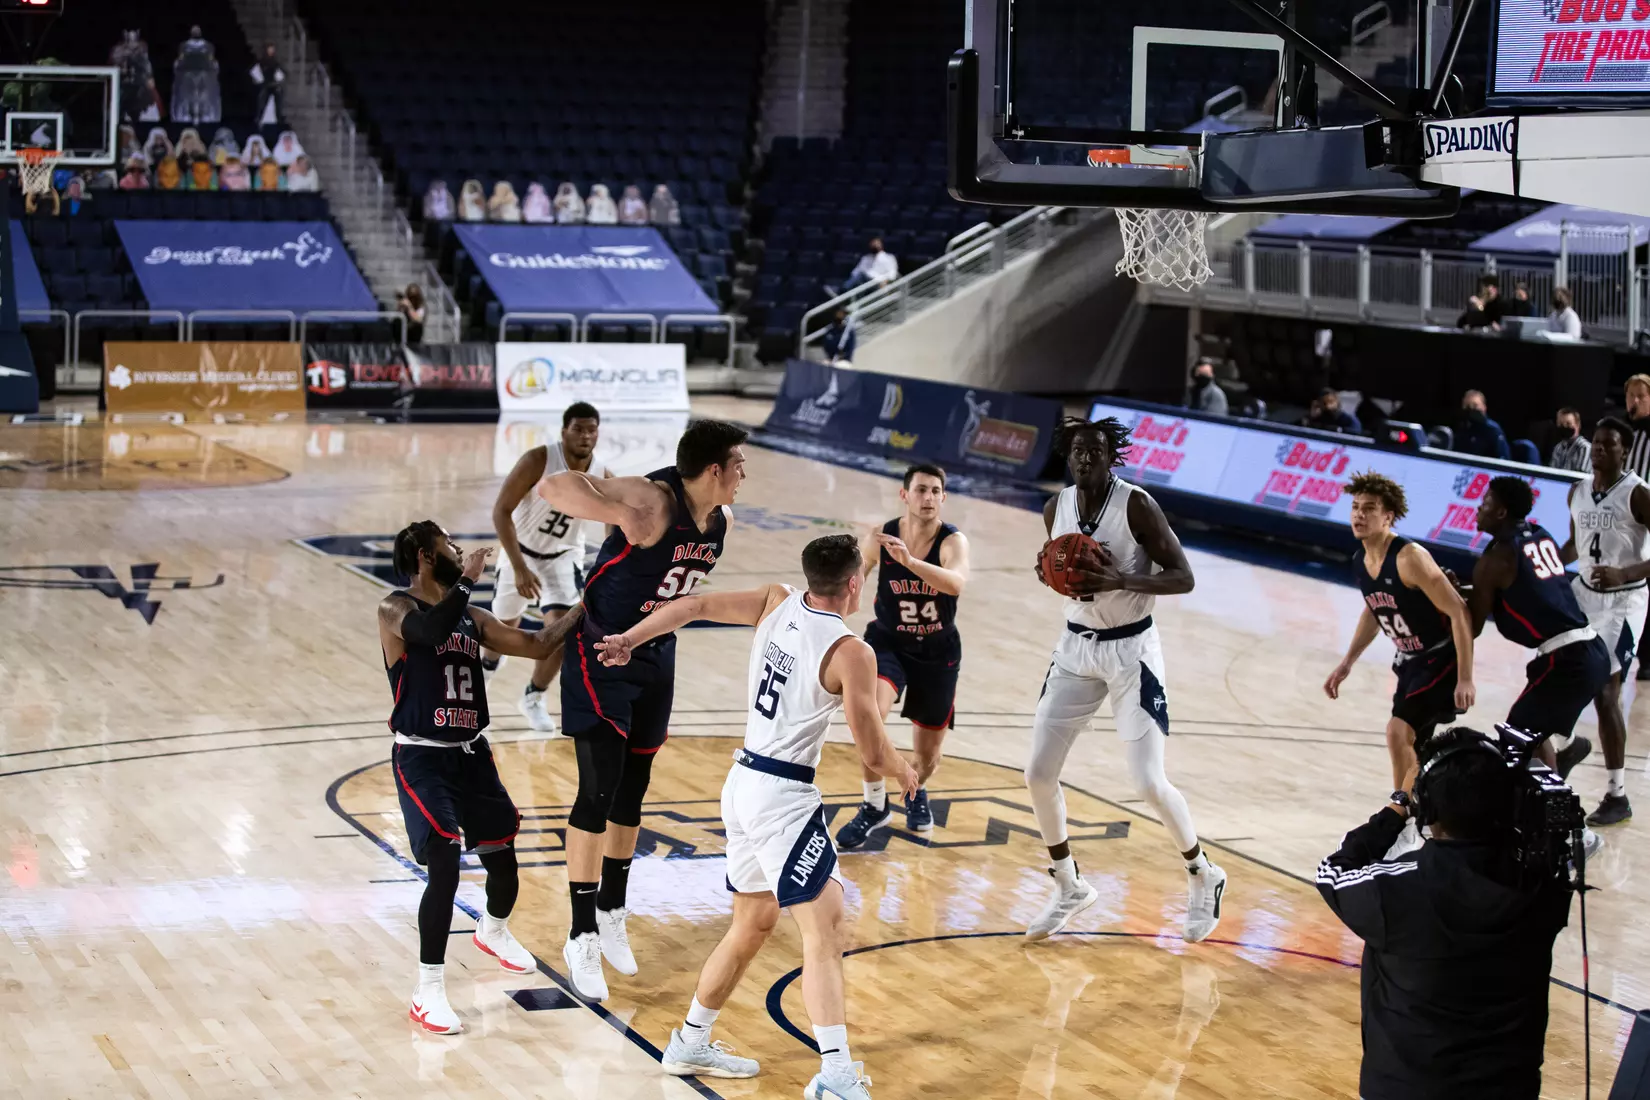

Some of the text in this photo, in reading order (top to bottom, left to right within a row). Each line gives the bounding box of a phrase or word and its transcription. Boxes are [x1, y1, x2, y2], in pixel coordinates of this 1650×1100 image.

[1556, 0, 1650, 24] Buds
[1532, 29, 1650, 83] TIRE PROS
[1424, 119, 1514, 158] SPALDING
[559, 368, 679, 384] MAGNOLIA
[1132, 416, 1189, 447] Bud's
[1284, 441, 1350, 475] Bud's
[1255, 469, 1304, 504] TIRE
[538, 509, 575, 539] 35
[1578, 511, 1614, 530] CBU
[672, 542, 717, 565] DIXI
[1055, 535, 1075, 572] Wilson
[1523, 538, 1565, 580] 30
[1589, 532, 1602, 564] 4
[655, 565, 708, 599] 50
[898, 599, 939, 624] 24
[1377, 613, 1412, 638] 54
[444, 664, 474, 701] 12
[754, 661, 789, 721] 25
[434, 707, 479, 730] STATE
[790, 830, 827, 888] LANCERS
